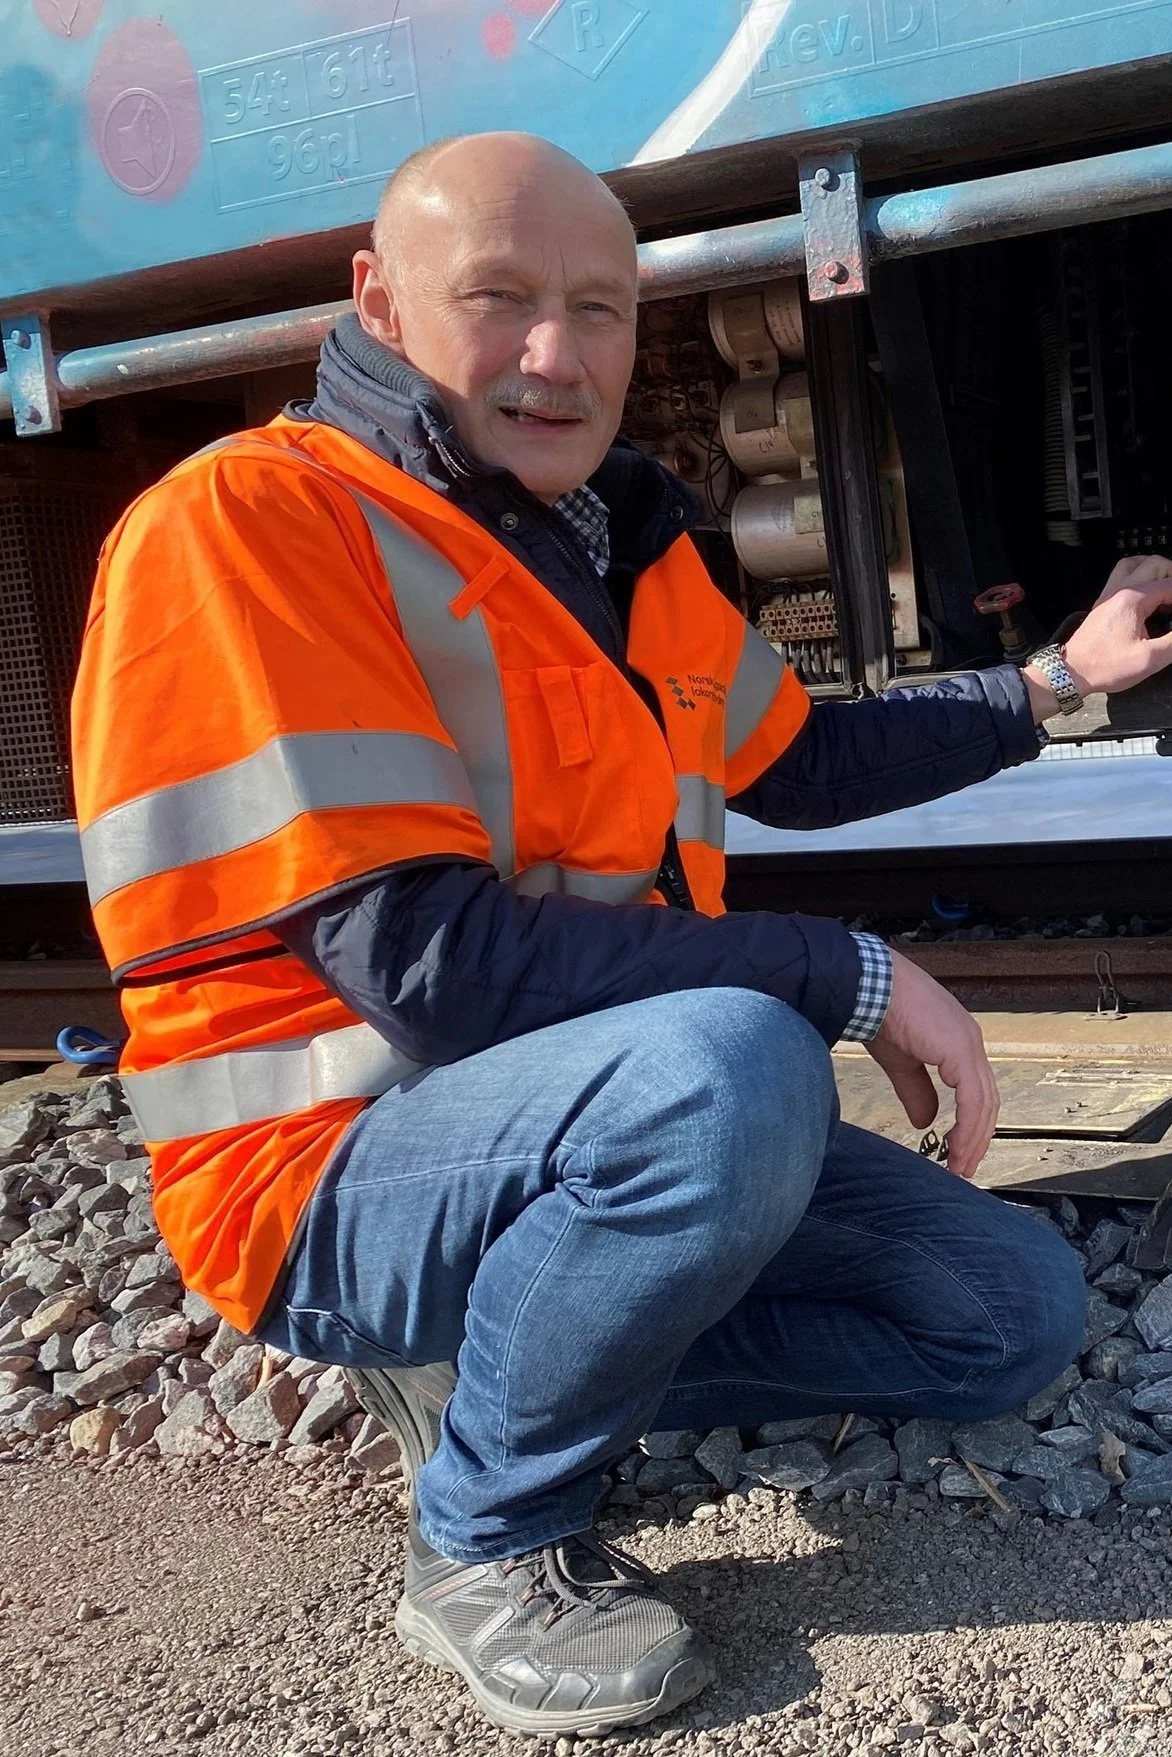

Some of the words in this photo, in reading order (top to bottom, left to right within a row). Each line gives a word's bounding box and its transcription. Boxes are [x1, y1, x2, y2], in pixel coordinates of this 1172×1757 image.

[571, 0, 604, 52] R
[752, 14, 865, 73] Rev.
[223, 70, 290, 125] 54t
[321, 44, 393, 99] 61t
[269, 115, 361, 182] 96pl
